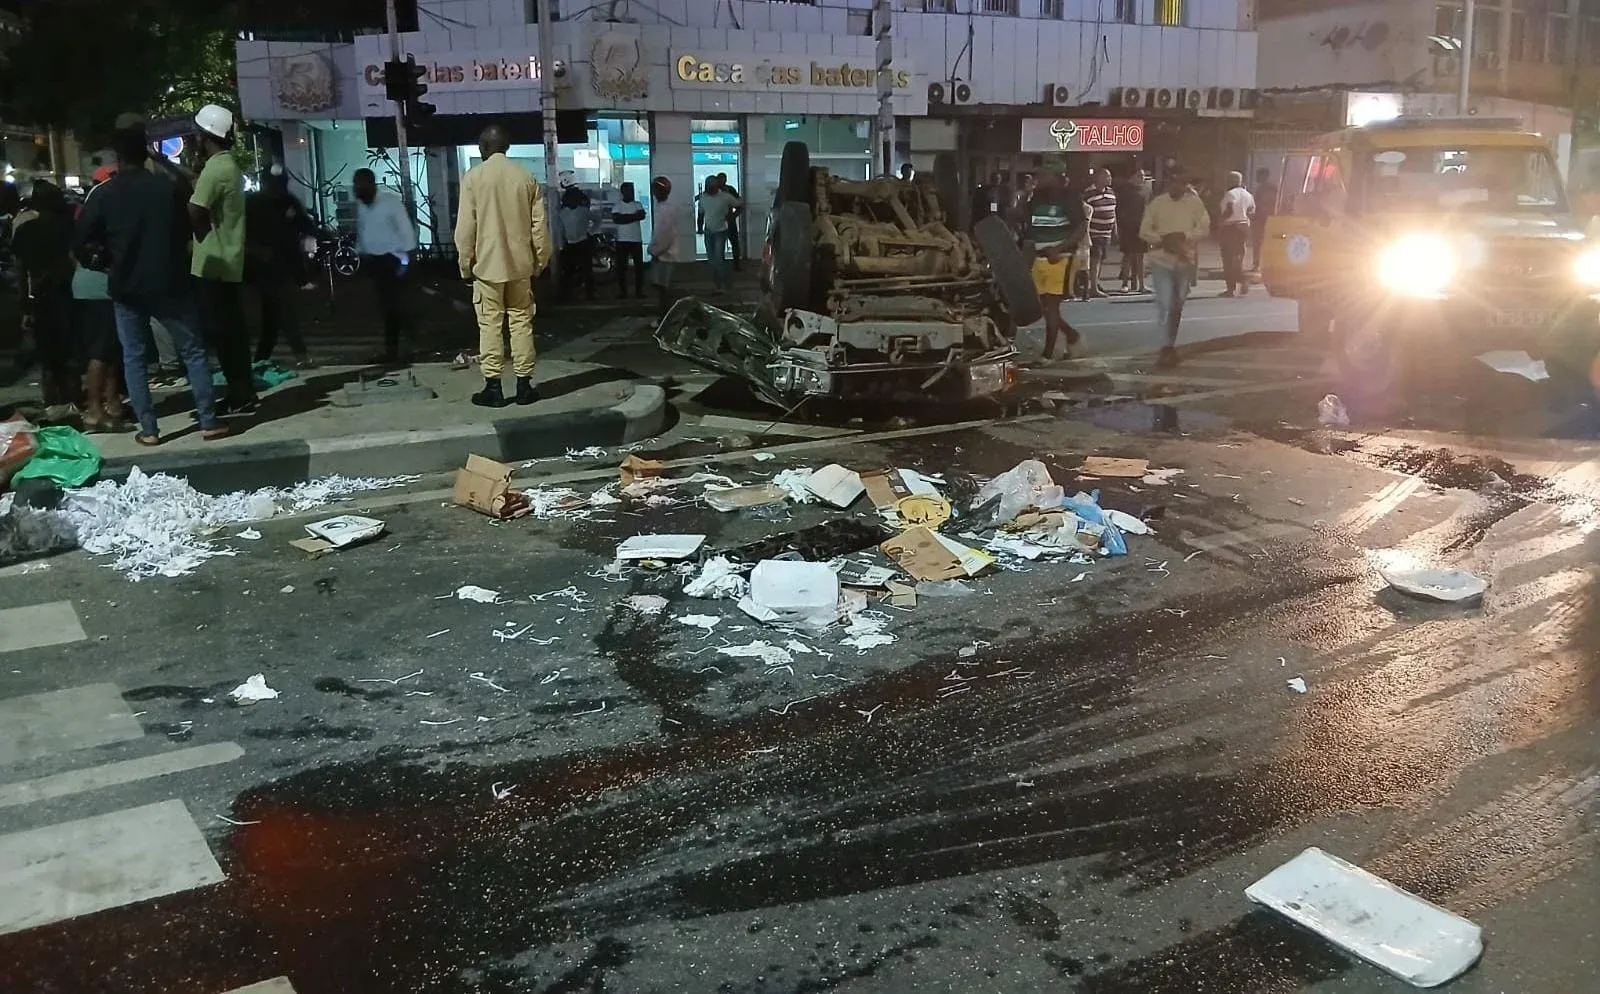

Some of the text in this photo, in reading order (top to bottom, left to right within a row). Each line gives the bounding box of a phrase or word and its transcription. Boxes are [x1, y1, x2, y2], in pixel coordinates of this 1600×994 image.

[677, 55, 744, 83] Casa
[810, 61, 912, 88] baters
[1076, 125, 1142, 146] TALHO
